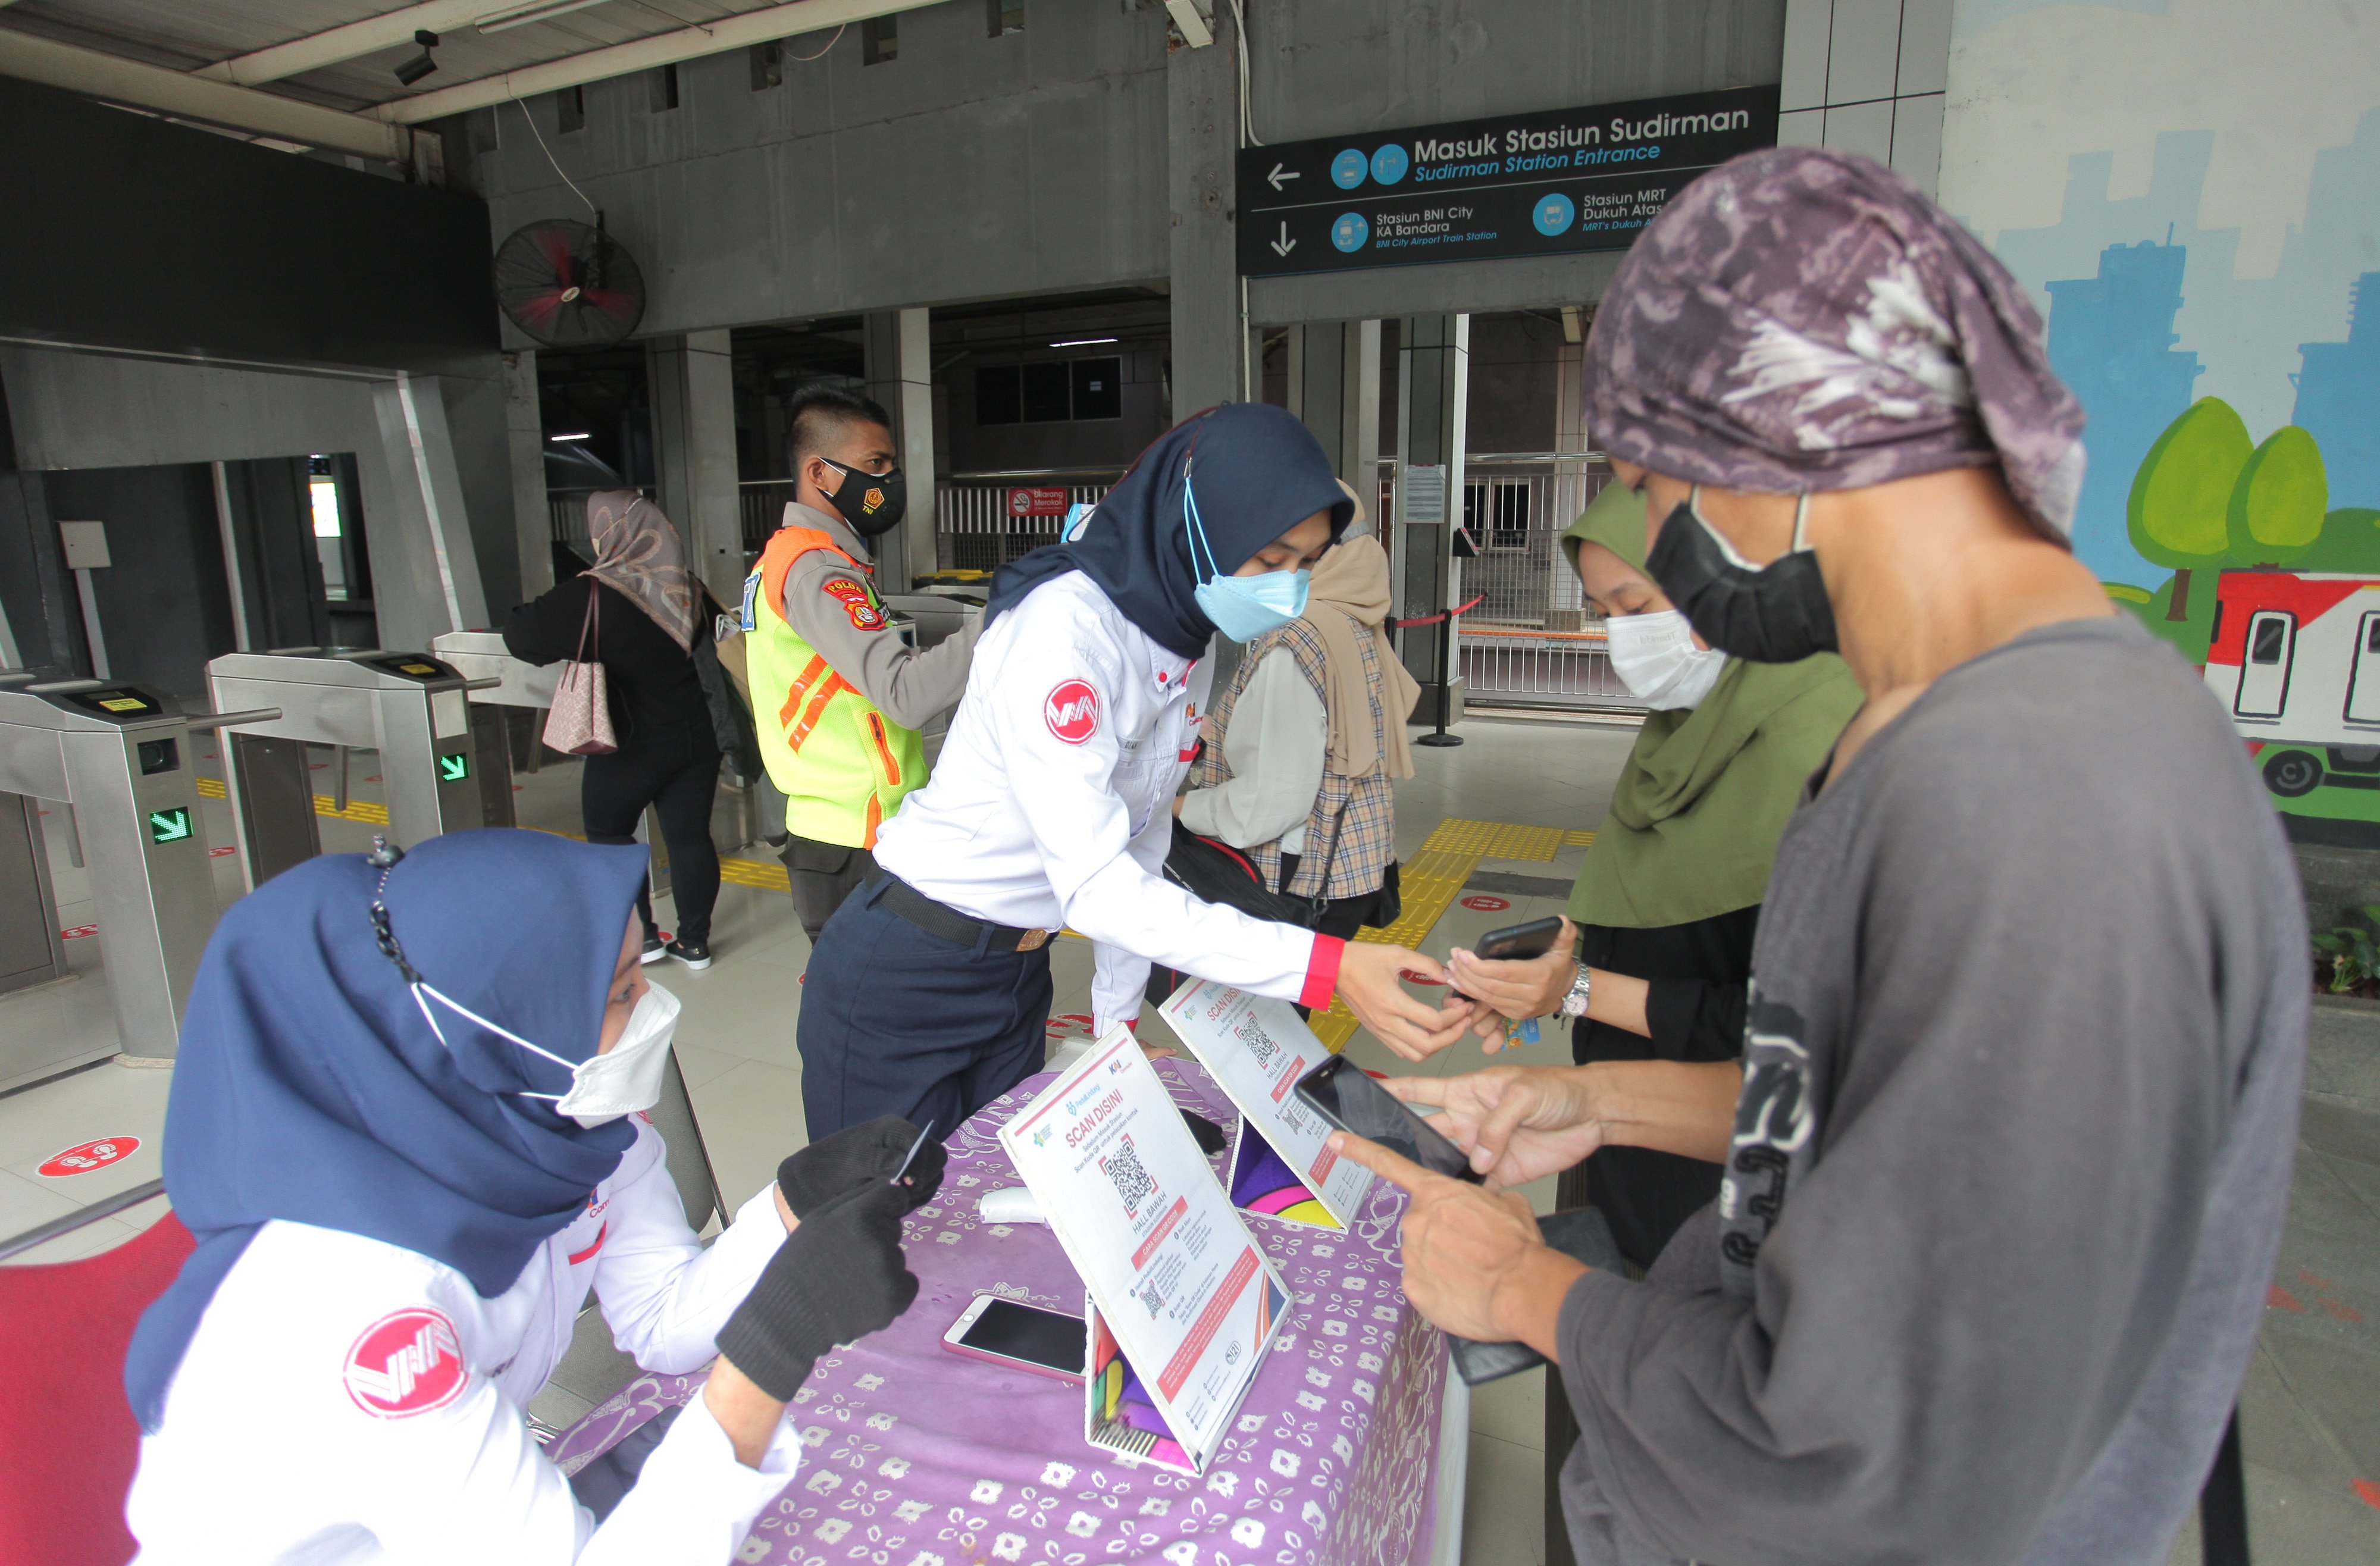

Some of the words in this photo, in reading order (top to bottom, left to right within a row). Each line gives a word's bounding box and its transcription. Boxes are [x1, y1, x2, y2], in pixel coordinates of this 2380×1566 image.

[1415, 133, 1497, 163] Masuk
[1505, 124, 1600, 153] Stasiun
[1610, 109, 1749, 142] Sudirman
[1415, 159, 1499, 182] Sudirman
[1505, 152, 1568, 173] Station
[1574, 144, 1660, 165] Entrance
[1583, 193, 1633, 207] Stasiun
[1637, 189, 1667, 202] MRT
[1376, 212, 1420, 225] Stasiun
[1424, 208, 1444, 221] BNI
[1448, 206, 1473, 220] City
[1583, 205, 1627, 220] Dukuh
[1631, 203, 1662, 216] Atas
[1376, 225, 1392, 237] KA
[1395, 222, 1450, 236] Bandara
[1582, 221, 1609, 231] MRT's
[1611, 218, 1642, 229] Dukuh
[1376, 240, 1390, 248] BNI
[1392, 238, 1408, 248] City
[1410, 236, 1440, 246] Airport
[1442, 234, 1464, 243] Train
[1465, 231, 1497, 241] Station
[1034, 489, 1064, 499] Dilarang
[862, 505, 873, 515] TNI
[1205, 997, 1227, 1022] SCAN
[1108, 1059, 1121, 1075] KAI
[1266, 1067, 1277, 1079] HALL
[1274, 1051, 1287, 1069] BAWAH
[1066, 1114, 1095, 1147] SCAN
[1093, 1089, 1122, 1122] DISINI
[1074, 1161, 1085, 1173] Scan
[1083, 1152, 1094, 1163] Kode
[1092, 1145, 1100, 1154] QR
[1100, 1135, 1111, 1147] untuk
[1110, 1119, 1126, 1138] pelacakan
[1126, 1108, 1138, 1120] kontak
[1082, 1135, 1099, 1152] Sebelum
[1097, 1124, 1110, 1136] Masuk
[1108, 1112, 1122, 1126] Stasiun
[1132, 1214, 1148, 1234] HALL
[1146, 1191, 1166, 1217] BAWAH
[1142, 1241, 1154, 1255] CARA
[1151, 1226, 1163, 1242] SCAN
[1167, 1209, 1178, 1224] CODE
